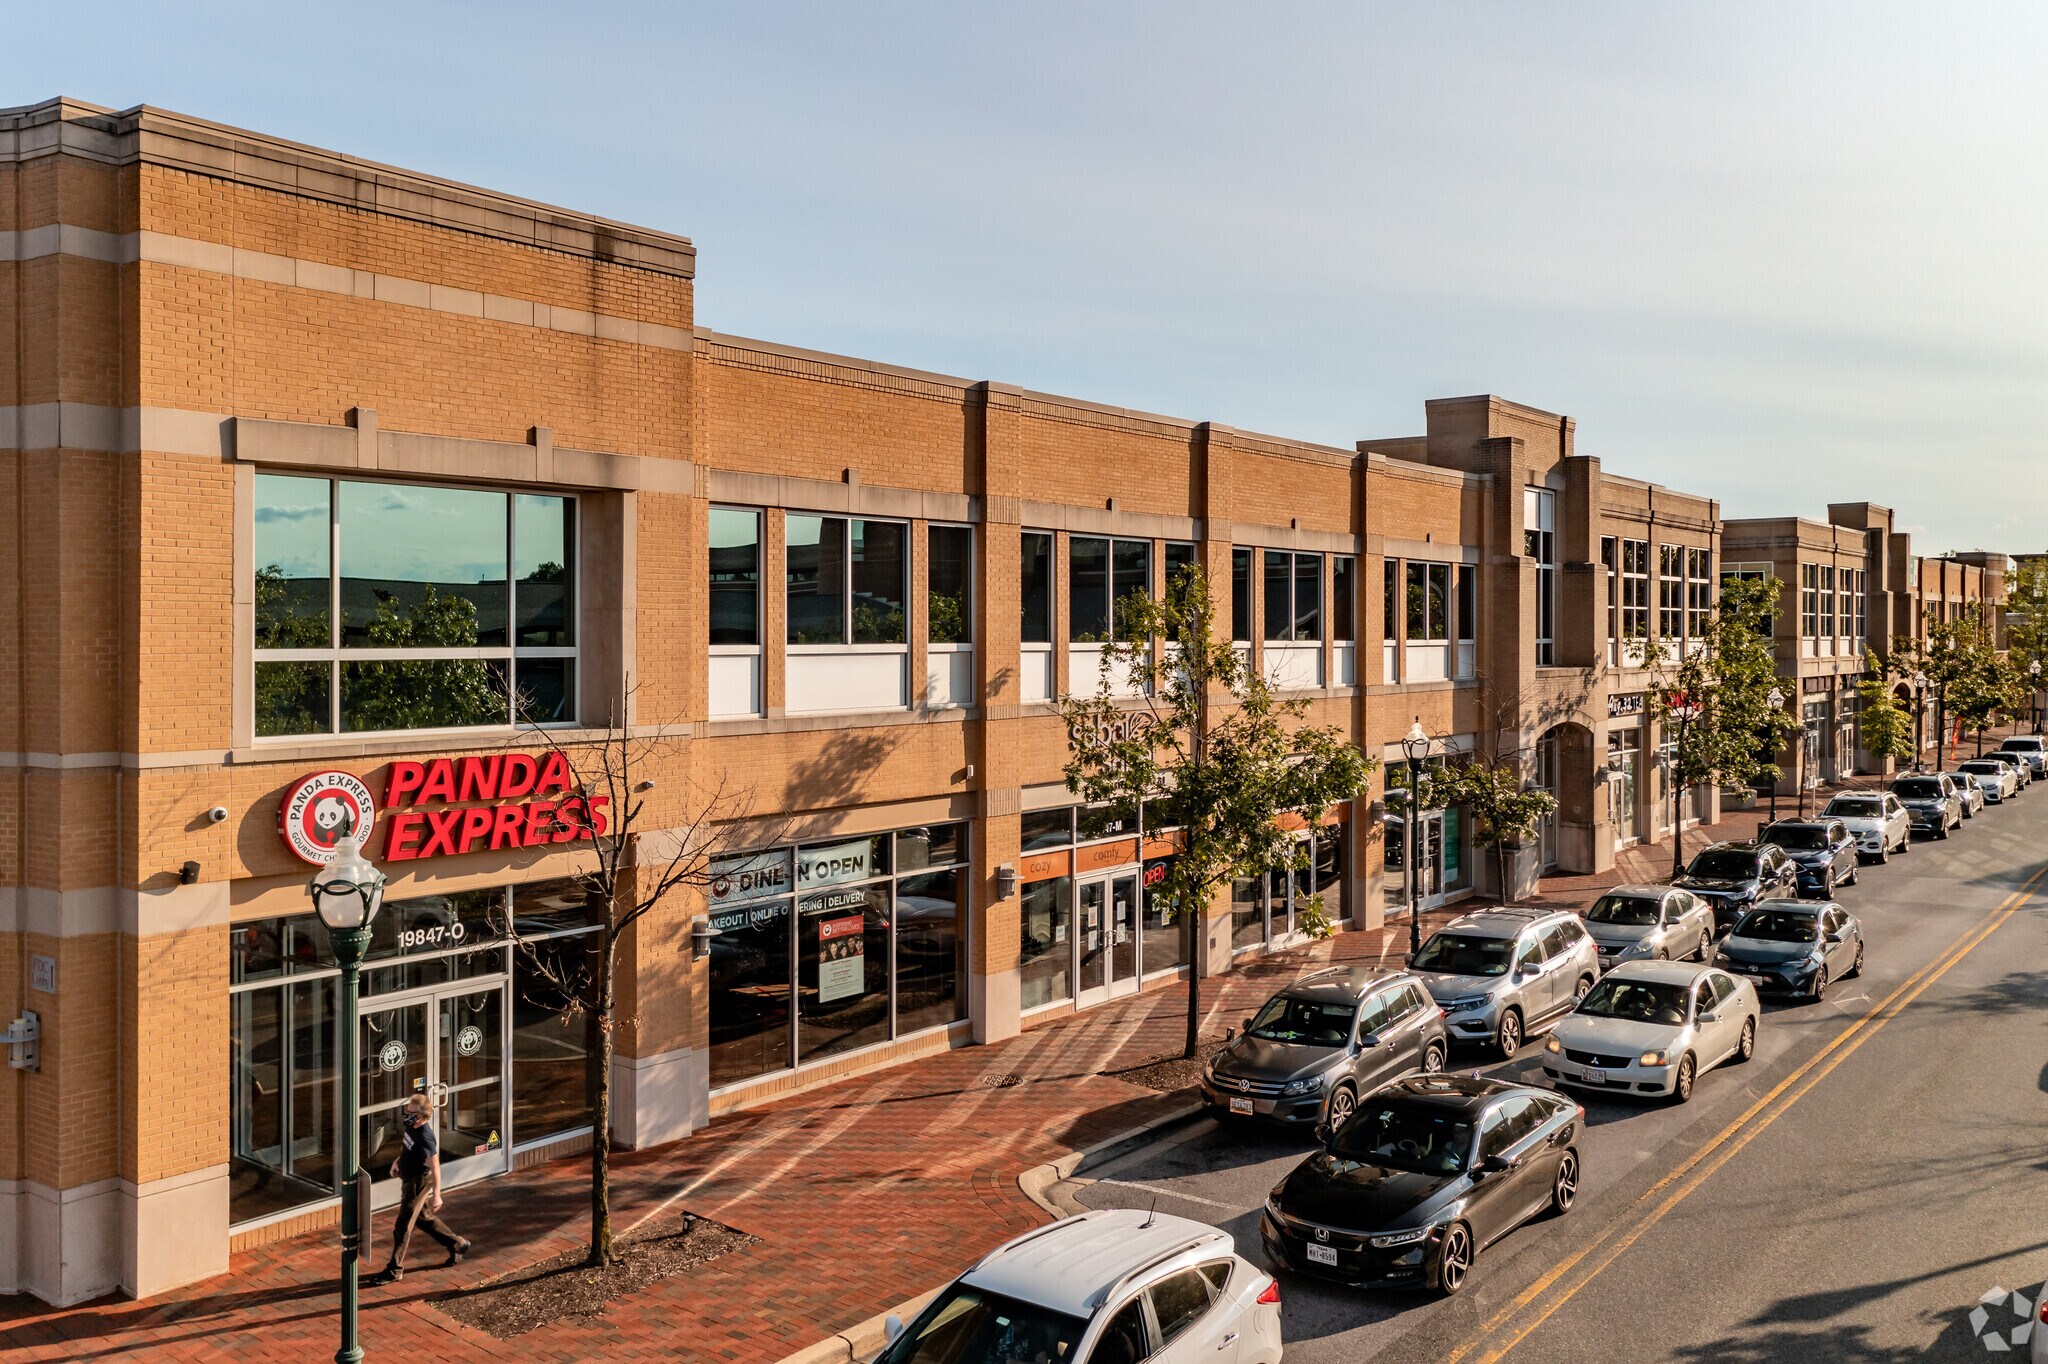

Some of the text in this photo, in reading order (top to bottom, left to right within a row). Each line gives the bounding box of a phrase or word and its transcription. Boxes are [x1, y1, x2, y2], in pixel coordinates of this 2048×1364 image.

[290, 775, 371, 820] PANDA EXPRESS
[382, 751, 572, 808] PANDA
[291, 832, 322, 861] GOURMET
[382, 796, 609, 862] EXPRESS
[740, 864, 810, 892] DINE-N
[816, 854, 864, 879] OPEN
[1030, 862, 1051, 875] cozy
[1093, 845, 1120, 863] comfy
[1143, 865, 1165, 887] OPEN
[709, 913, 744, 930] AKEOUT
[752, 906, 779, 921] ONLINE
[829, 891, 866, 907] DELIVERY
